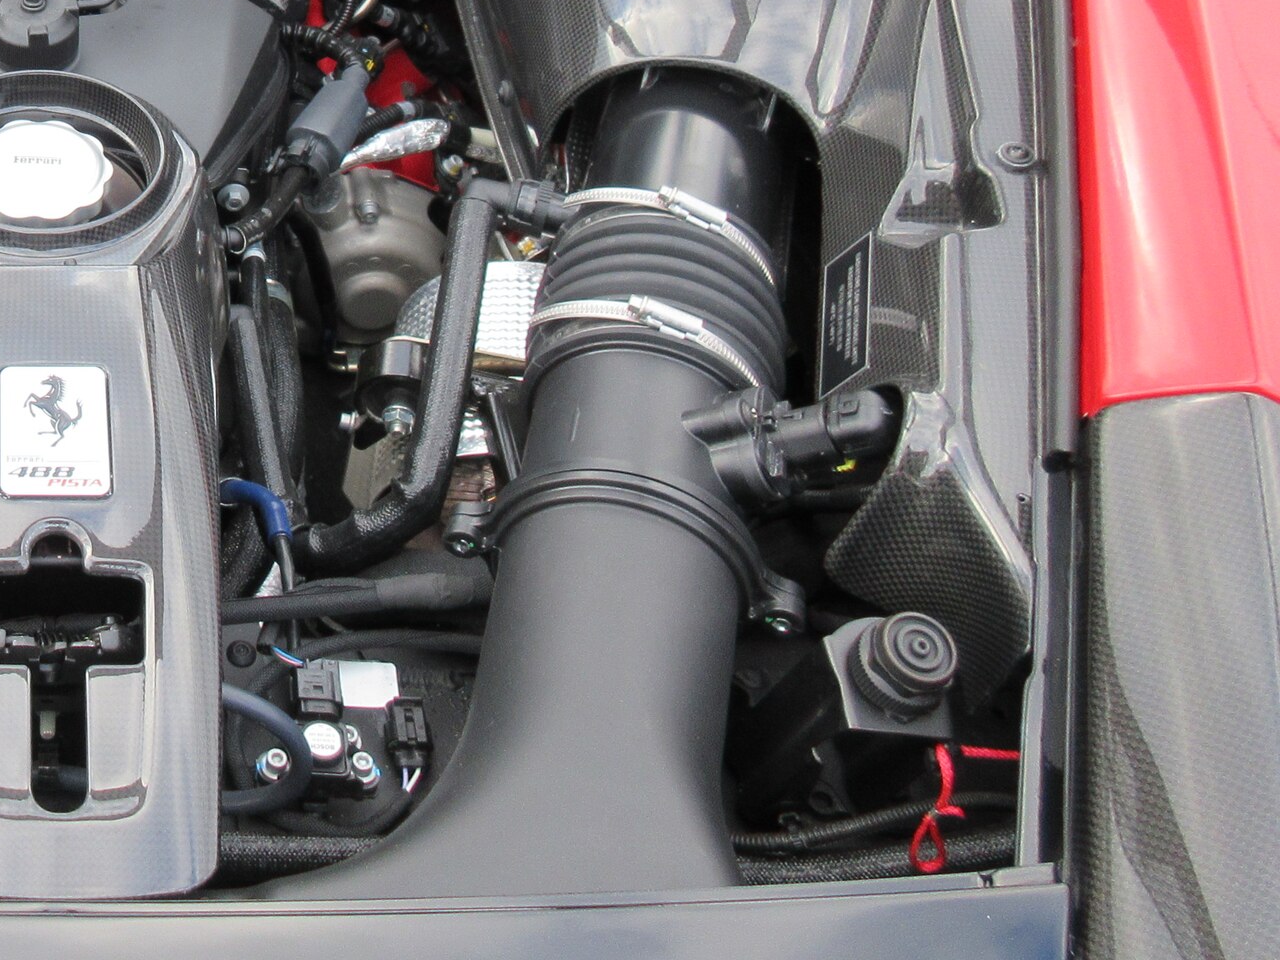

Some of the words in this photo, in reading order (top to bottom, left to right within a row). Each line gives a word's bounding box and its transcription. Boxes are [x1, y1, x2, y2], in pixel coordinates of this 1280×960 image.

[13, 155, 62, 165] Ferrari
[8, 466, 75, 478] 488
[47, 478, 103, 488] PISTA
[310, 743, 336, 751] BOSCH
